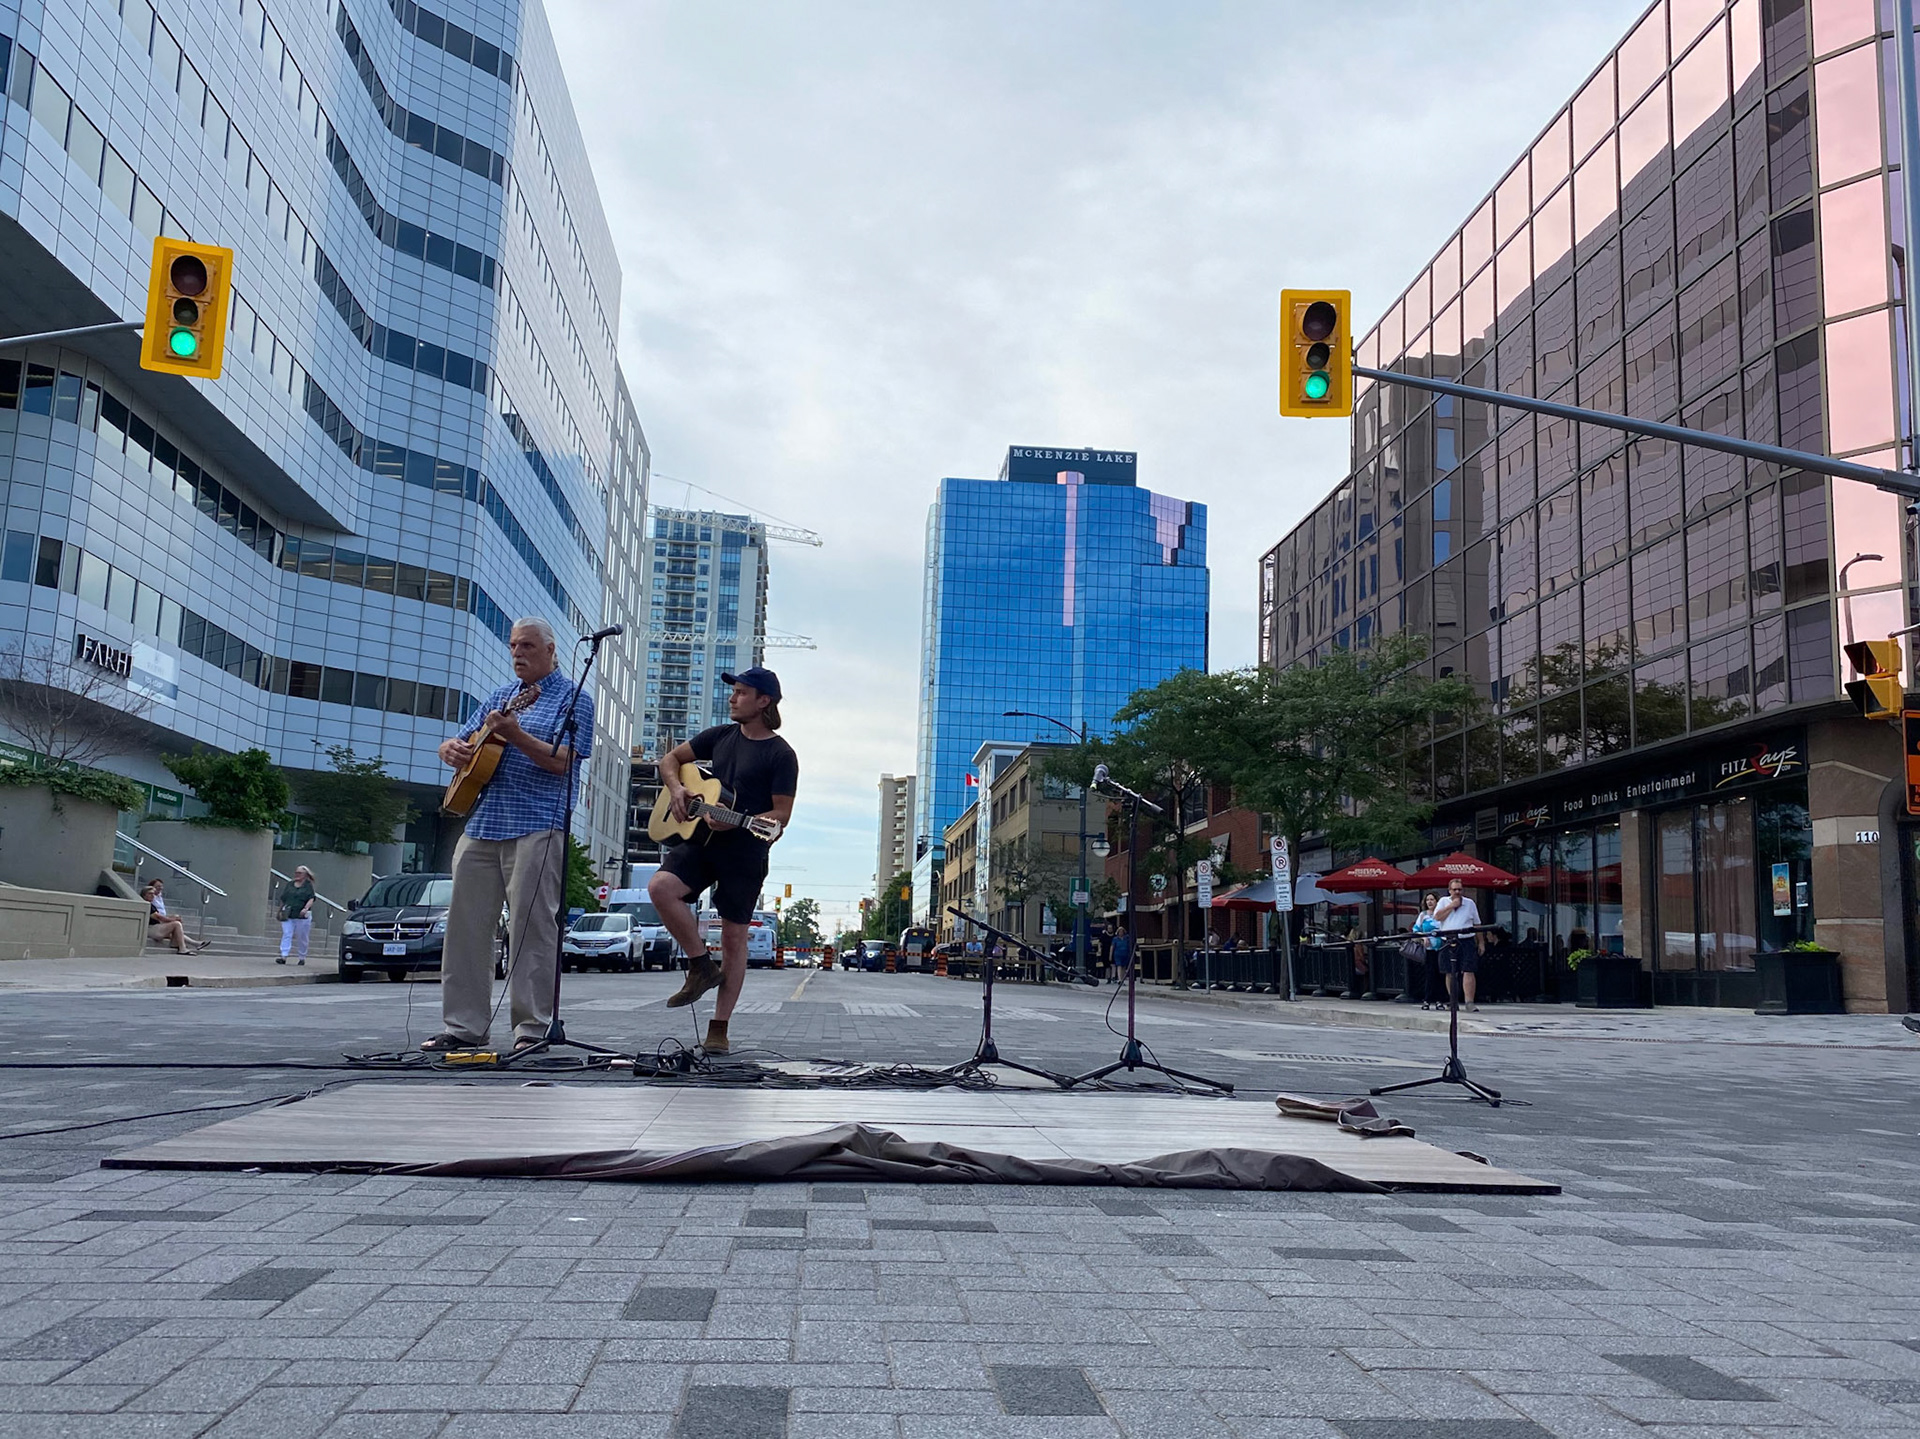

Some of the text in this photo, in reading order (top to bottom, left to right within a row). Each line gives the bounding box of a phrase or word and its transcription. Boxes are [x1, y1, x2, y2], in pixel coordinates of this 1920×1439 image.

[1013, 448, 1134, 464] MCKENZIE LAKE
[82, 634, 135, 678] FARHI
[1721, 758, 1747, 776] FITZ
[1563, 771, 1696, 812] Food Drinks Entertainment
[1856, 831, 1880, 843] 110
